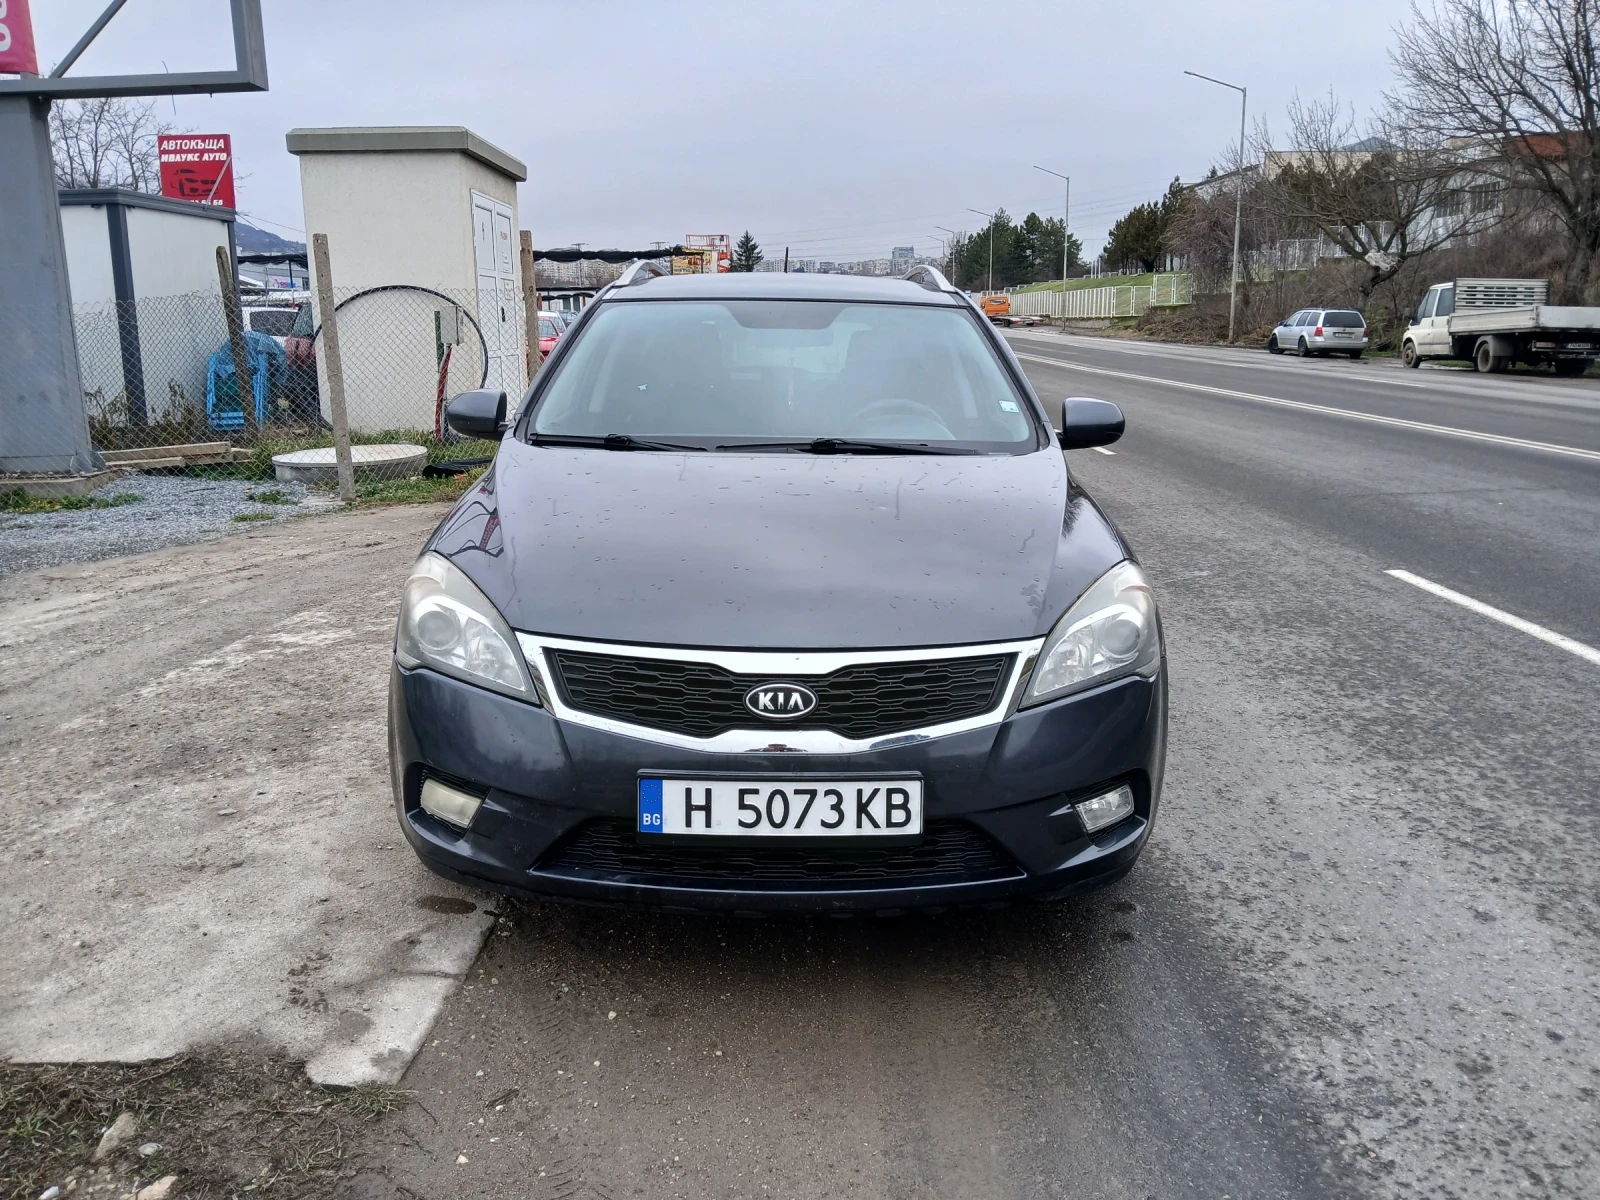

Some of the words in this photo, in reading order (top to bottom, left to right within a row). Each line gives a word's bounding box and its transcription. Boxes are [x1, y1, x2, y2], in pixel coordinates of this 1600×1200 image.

[160, 139, 225, 150] АВТОКЪЩА
[160, 153, 200, 163] ИВЛУКС
[202, 153, 227, 161] АУТО
[758, 692, 805, 711] KIA
[684, 787, 713, 829] H
[643, 813, 661, 826] BG
